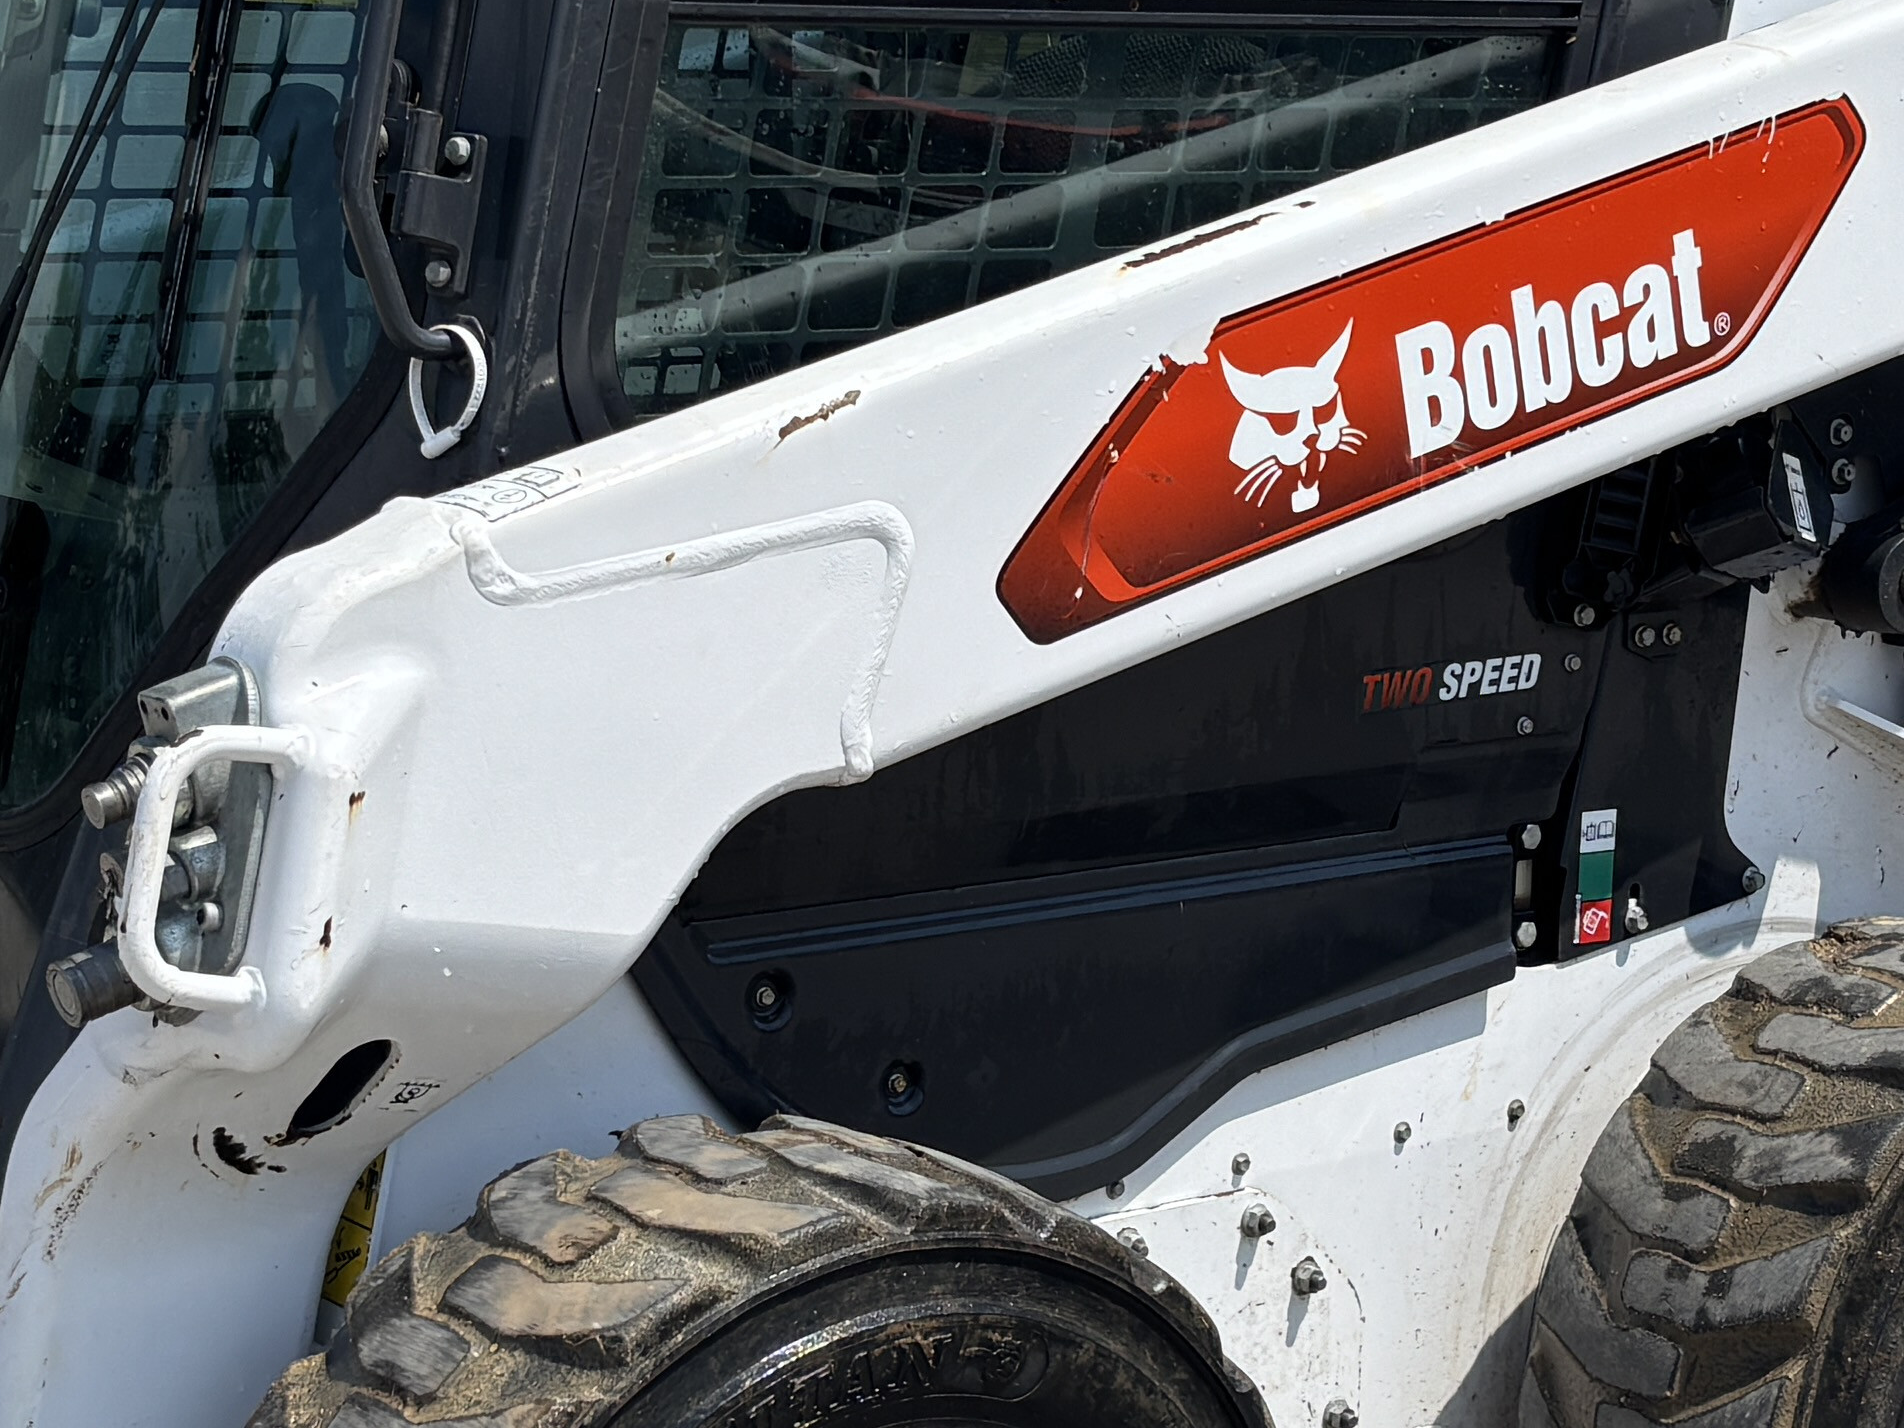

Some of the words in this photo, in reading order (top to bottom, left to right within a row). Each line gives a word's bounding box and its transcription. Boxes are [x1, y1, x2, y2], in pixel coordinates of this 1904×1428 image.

[1394, 228, 1711, 460] Bobcat
[1362, 667, 1432, 712] TWO
[1439, 653, 1542, 701] SPEED
